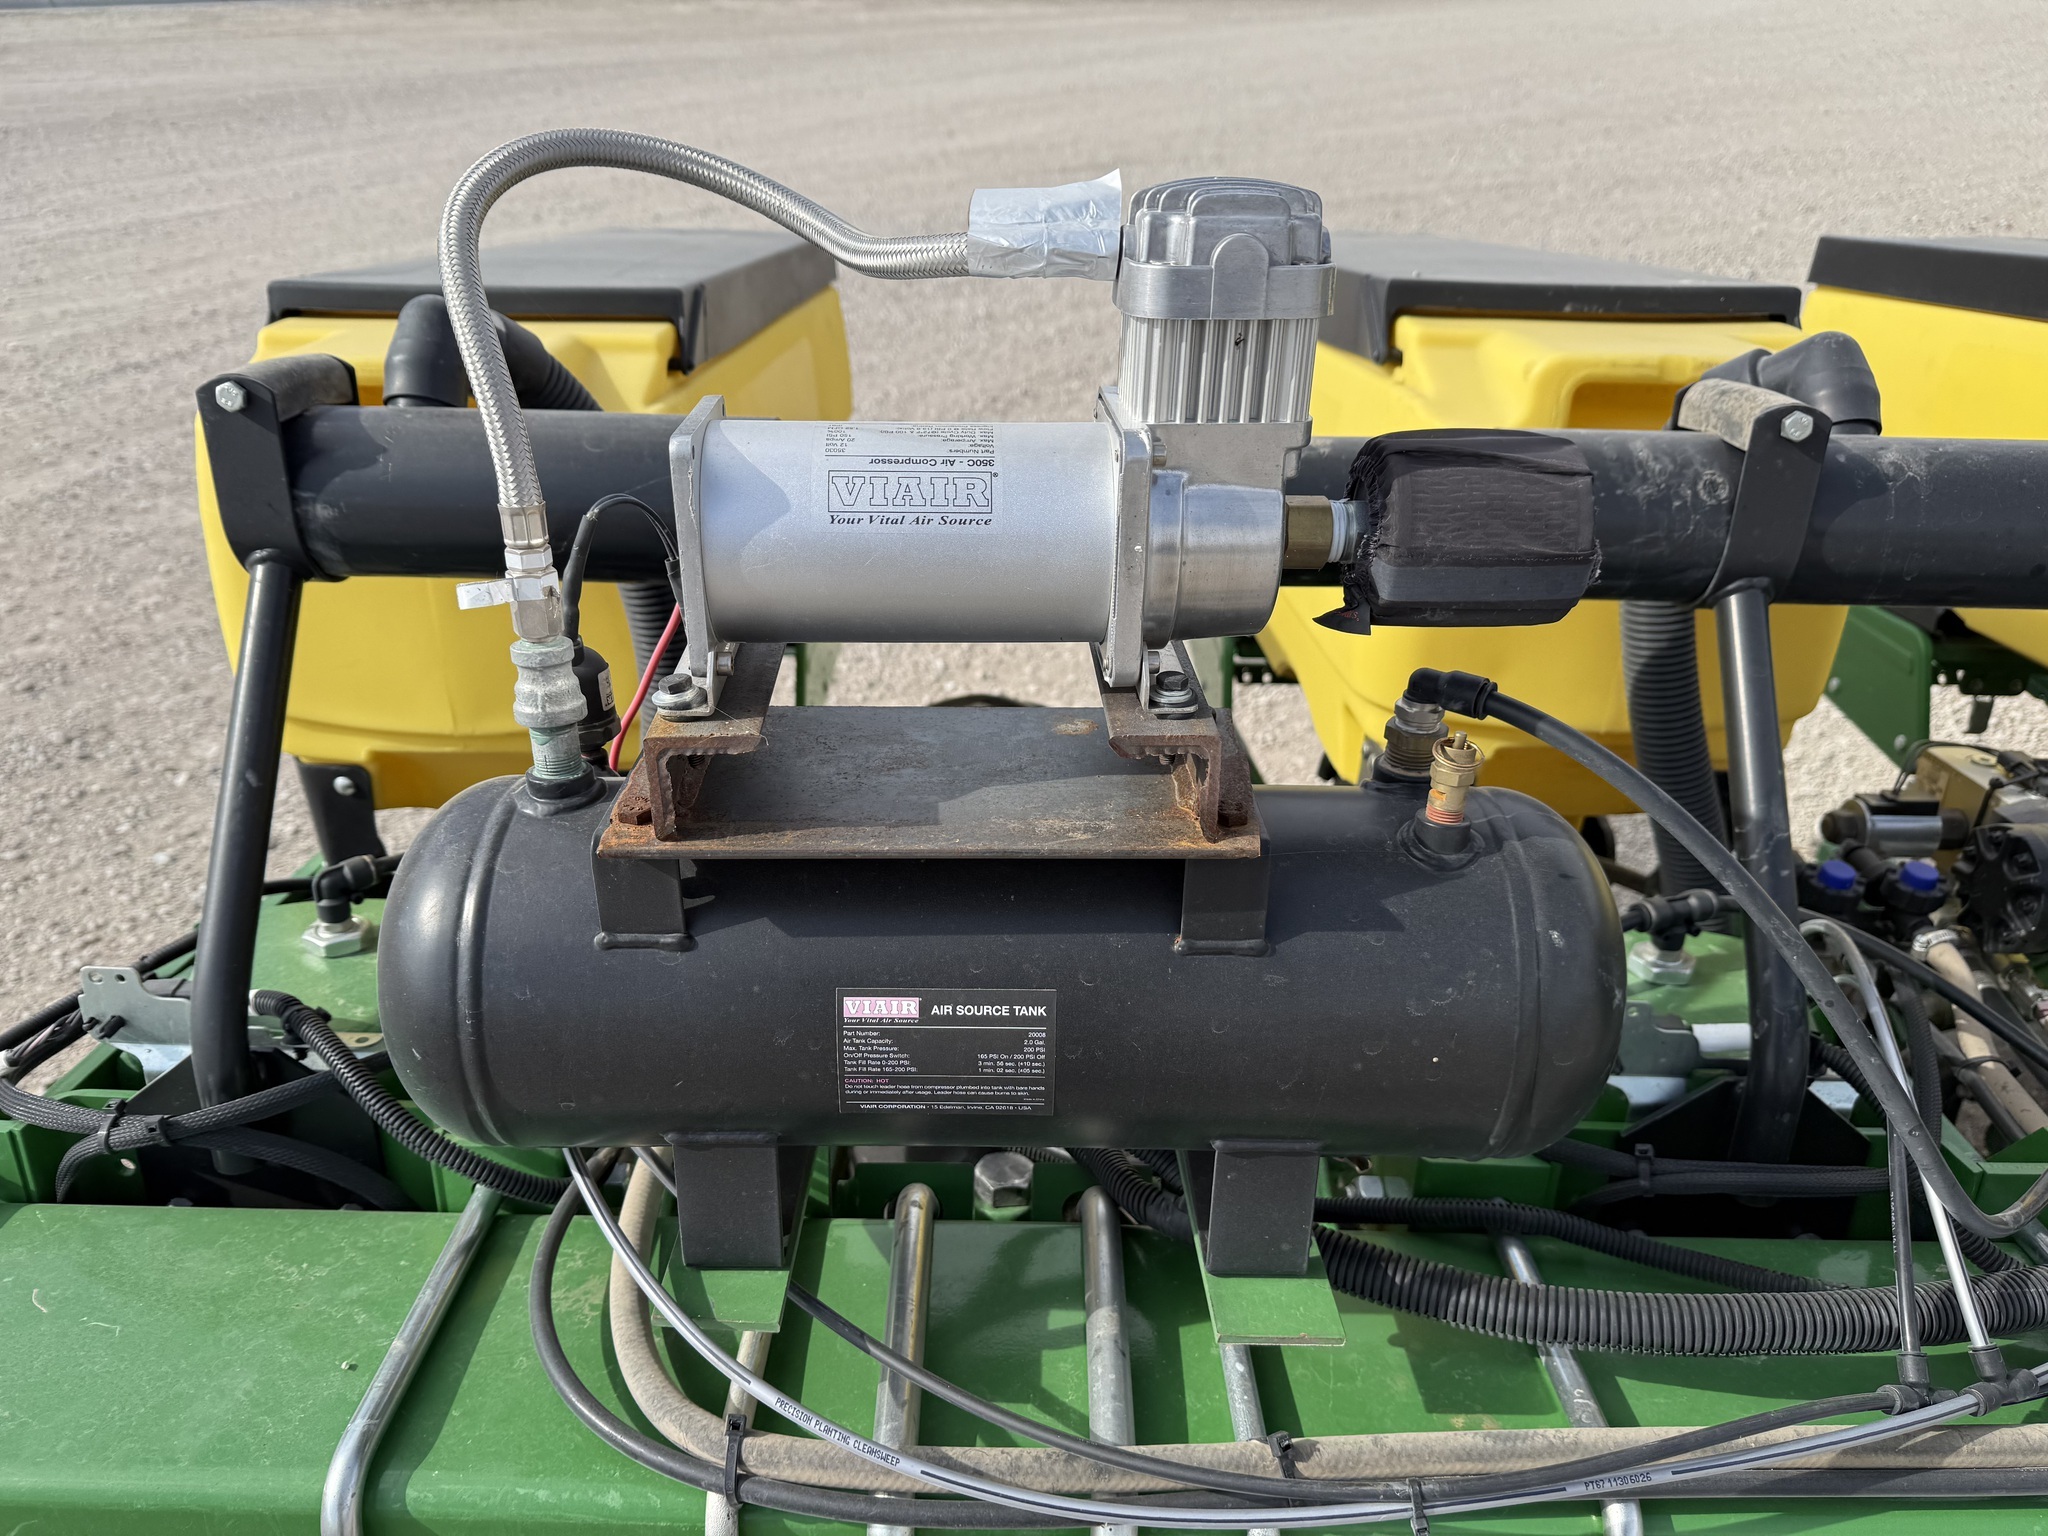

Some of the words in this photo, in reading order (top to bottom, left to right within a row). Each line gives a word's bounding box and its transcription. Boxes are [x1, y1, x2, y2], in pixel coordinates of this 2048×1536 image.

[869, 459, 937, 467] Compressor
[967, 459, 995, 467] 350C
[832, 476, 990, 507] VIAIR
[829, 514, 864, 526] Your
[868, 515, 905, 526] Vital
[909, 516, 934, 526] Air
[938, 515, 992, 526] Source
[845, 1000, 917, 1015] VIAIR
[931, 1005, 953, 1015] AIR
[956, 1005, 1010, 1016] SOURCE
[1013, 1006, 1047, 1016] TANK
[775, 1397, 813, 1425] PRECISION
[814, 1420, 850, 1446] PLANTING
[852, 1440, 901, 1467] CLEANSWEEP
[1584, 1479, 1605, 1490] PT67
